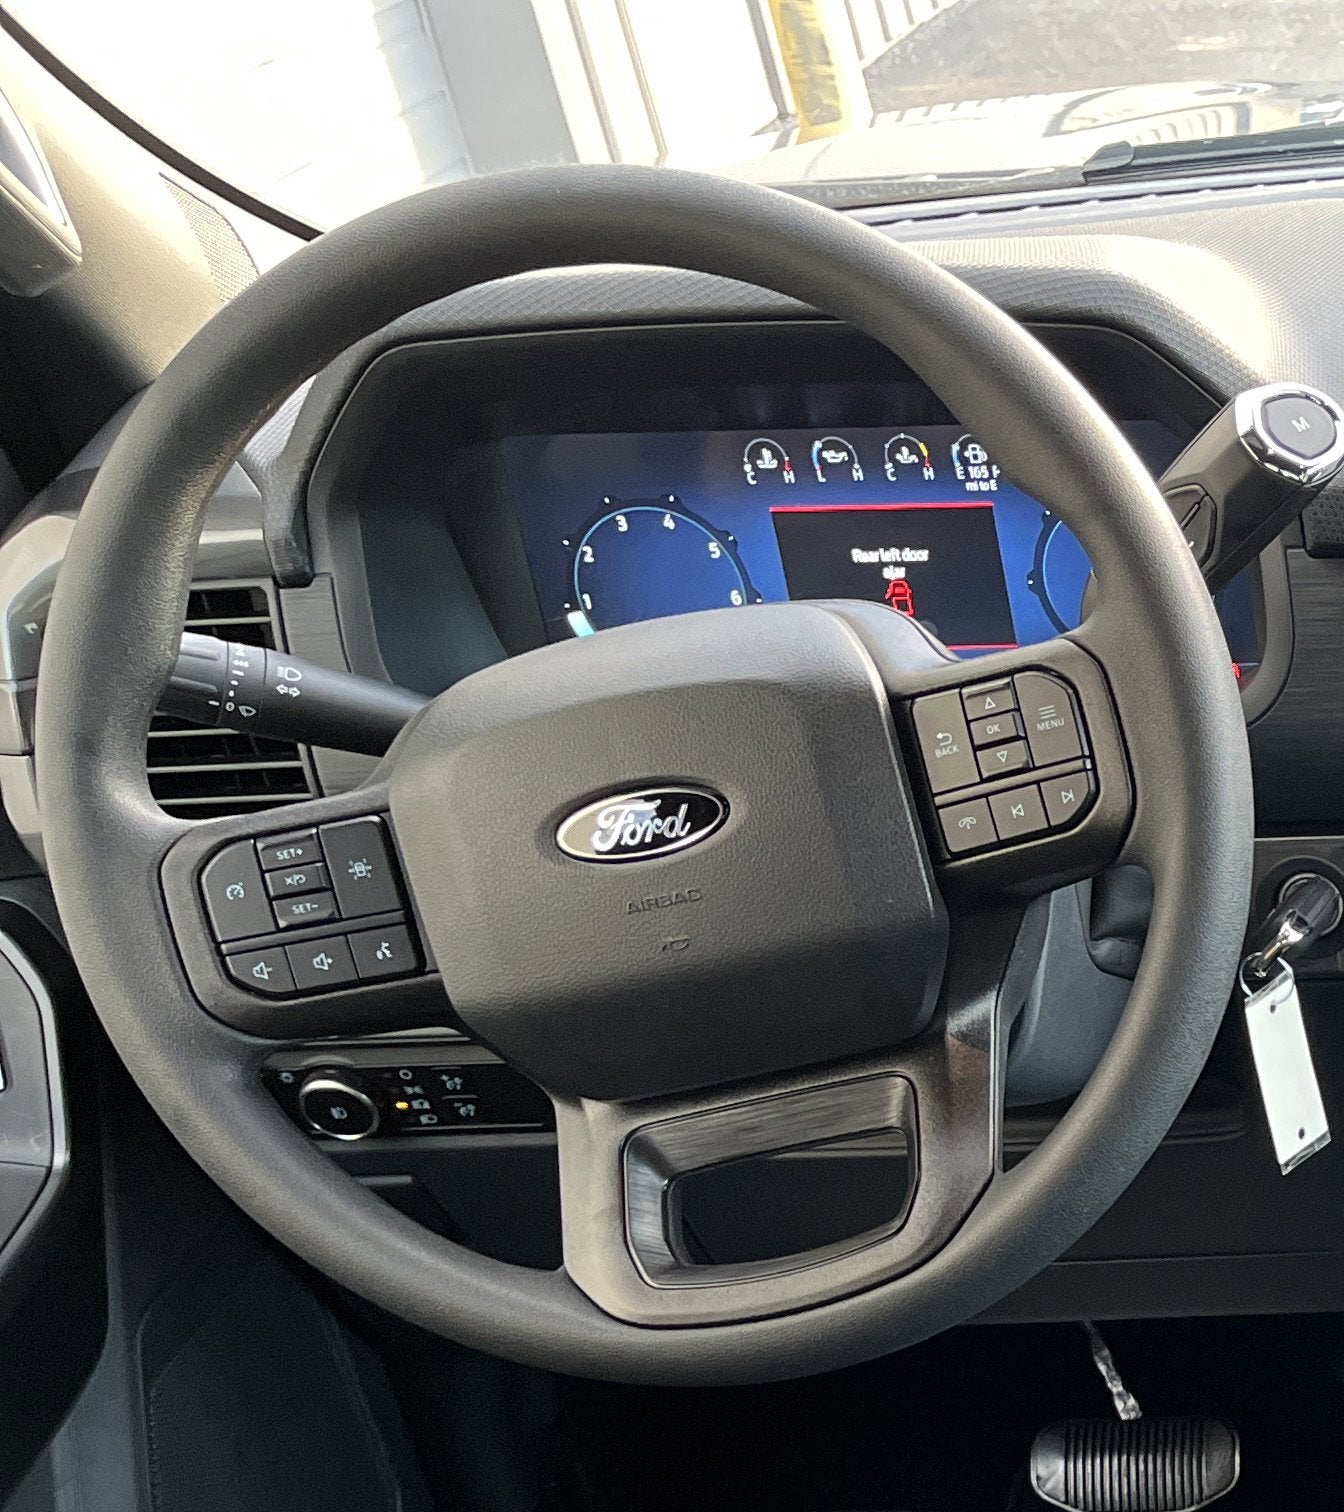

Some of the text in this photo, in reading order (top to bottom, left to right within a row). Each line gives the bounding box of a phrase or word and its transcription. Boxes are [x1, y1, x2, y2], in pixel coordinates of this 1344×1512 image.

[1291, 415, 1311, 433] M
[746, 471, 757, 485] C
[783, 470, 795, 484] H
[816, 469, 827, 483] L
[852, 467, 864, 481] H
[886, 467, 897, 481] C
[923, 466, 935, 480] H
[615, 514, 628, 532] 3
[663, 513, 676, 530] 4
[582, 545, 595, 563] 2
[708, 541, 721, 559] 5
[879, 547, 901, 562] left
[901, 547, 929, 562] door
[582, 593, 592, 610] 1
[729, 589, 743, 606] 6
[986, 724, 1000, 735] OK
[1036, 717, 1065, 731] MENU
[934, 744, 960, 759] BACK
[591, 799, 692, 853] Ford
[626, 888, 703, 915] AIRBAG
